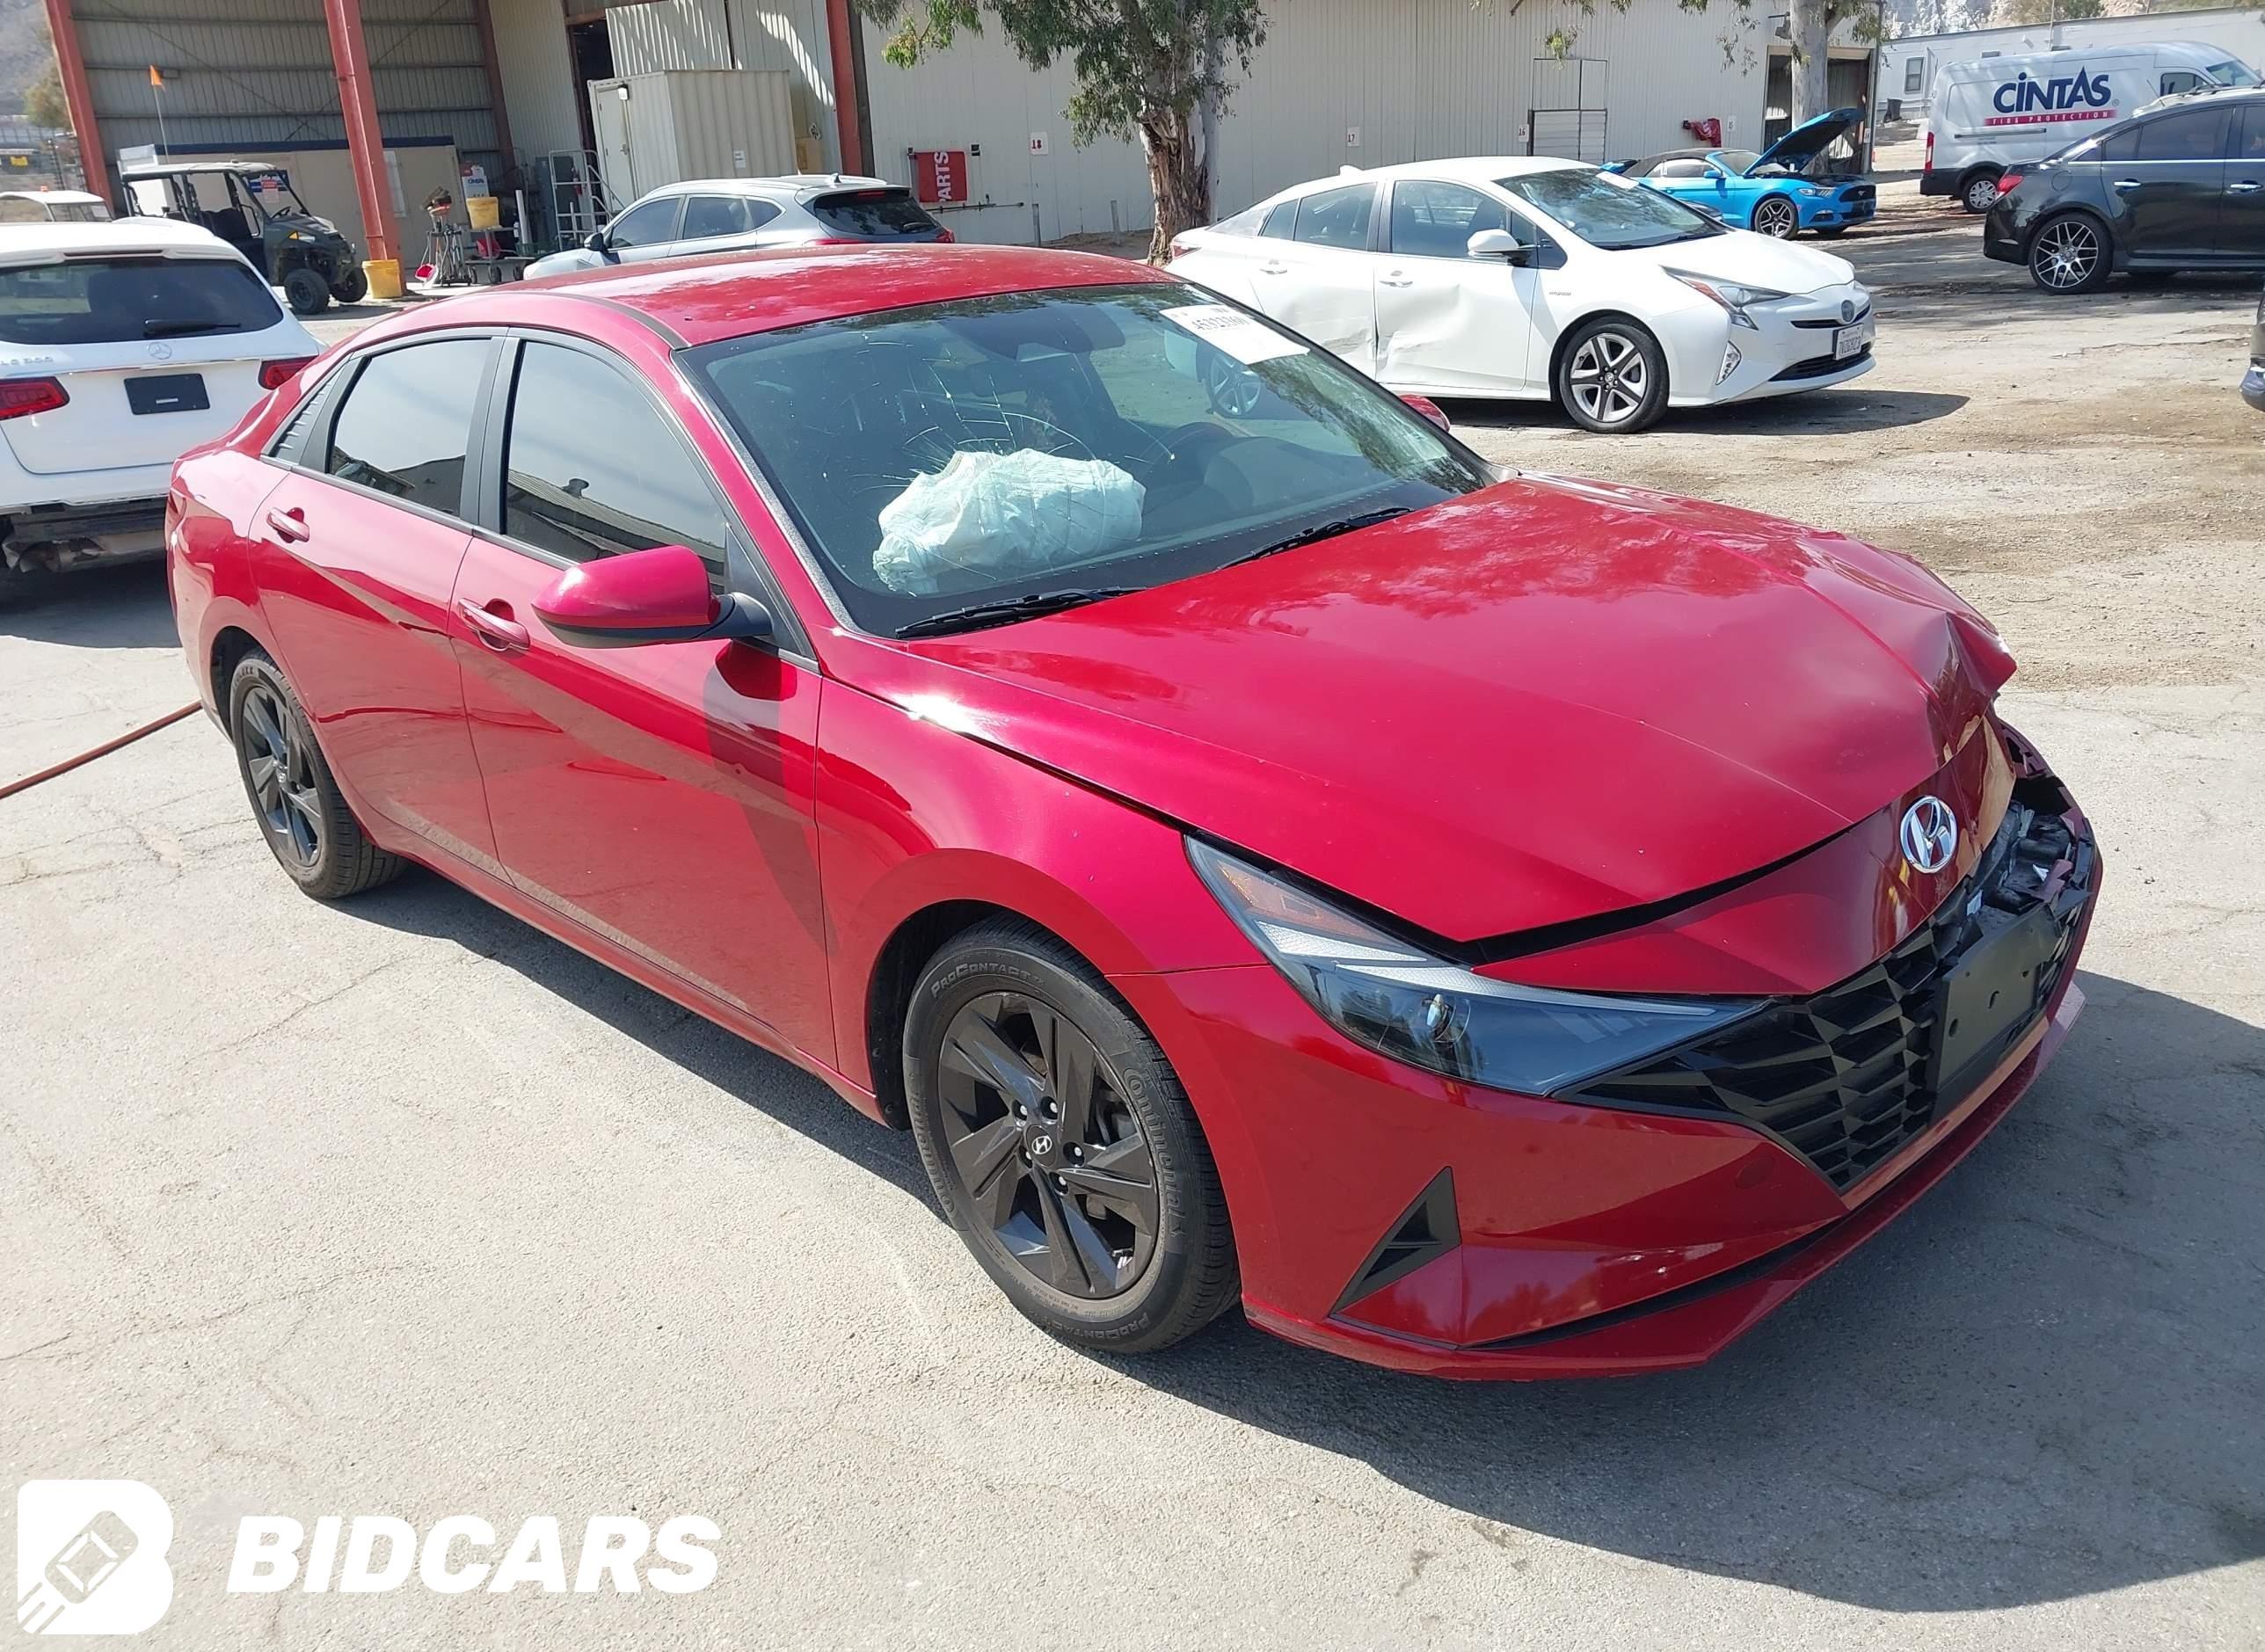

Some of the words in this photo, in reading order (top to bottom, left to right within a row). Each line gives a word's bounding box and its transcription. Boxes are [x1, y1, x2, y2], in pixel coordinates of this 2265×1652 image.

[2028, 111, 2109, 123] PROTECTION
[1031, 139, 1042, 149] 18
[934, 152, 951, 202] ARTS
[1123, 1067, 1186, 1219] Continental
